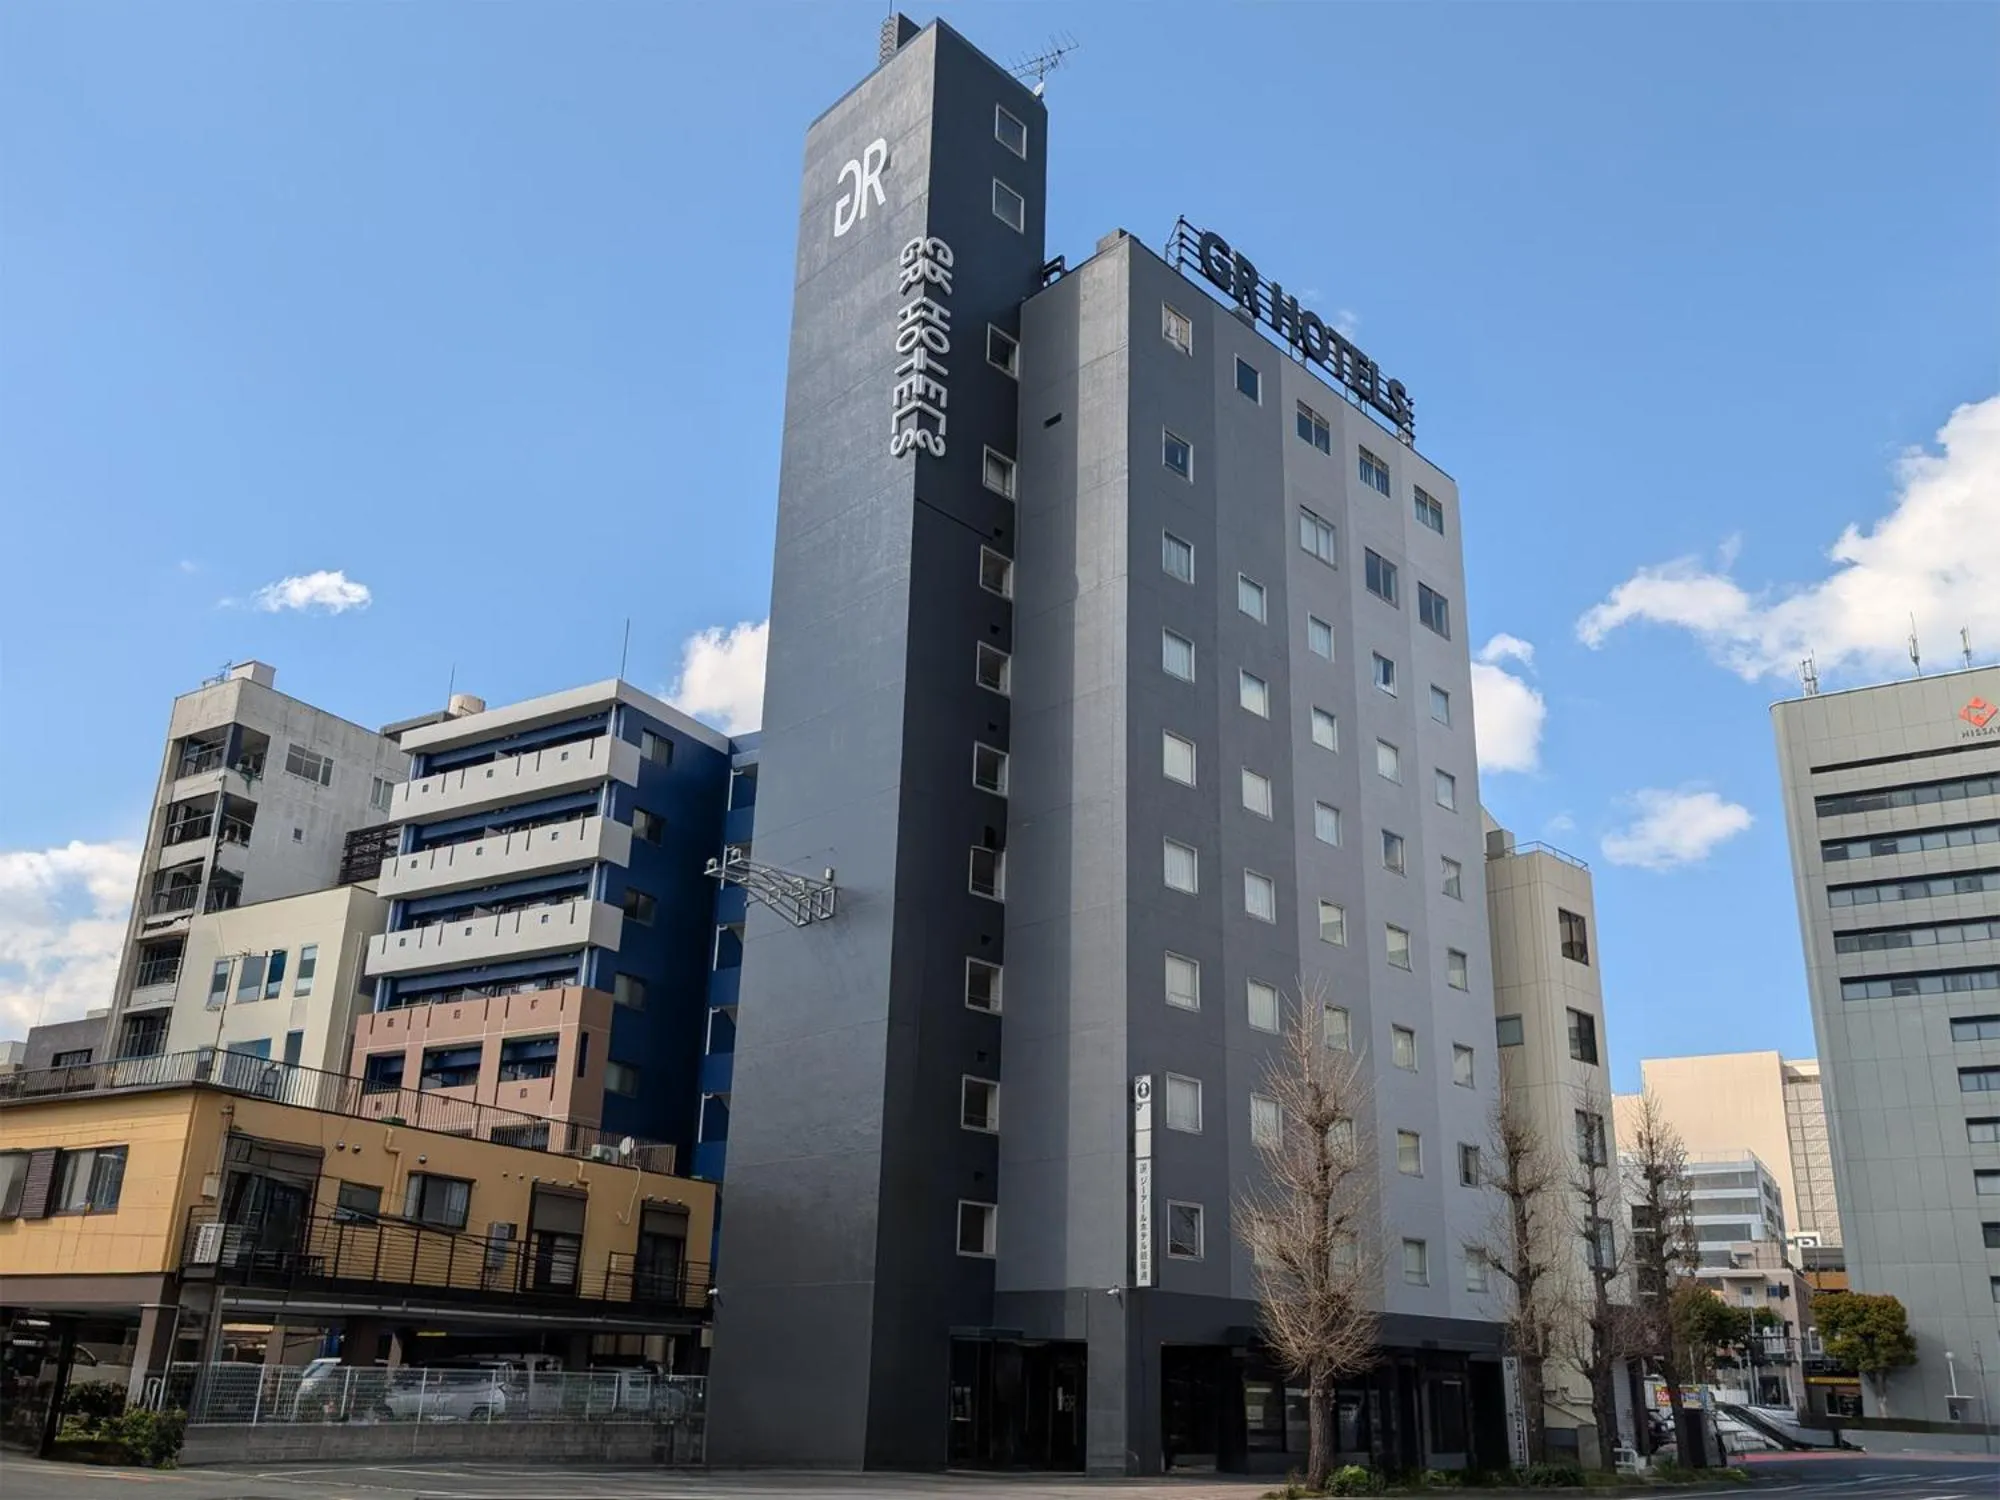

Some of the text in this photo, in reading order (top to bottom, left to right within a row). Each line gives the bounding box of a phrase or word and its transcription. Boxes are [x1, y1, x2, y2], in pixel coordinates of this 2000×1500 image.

[890, 236, 925, 457] GR HOTELS
[1199, 231, 1409, 424] GR HOTELS
